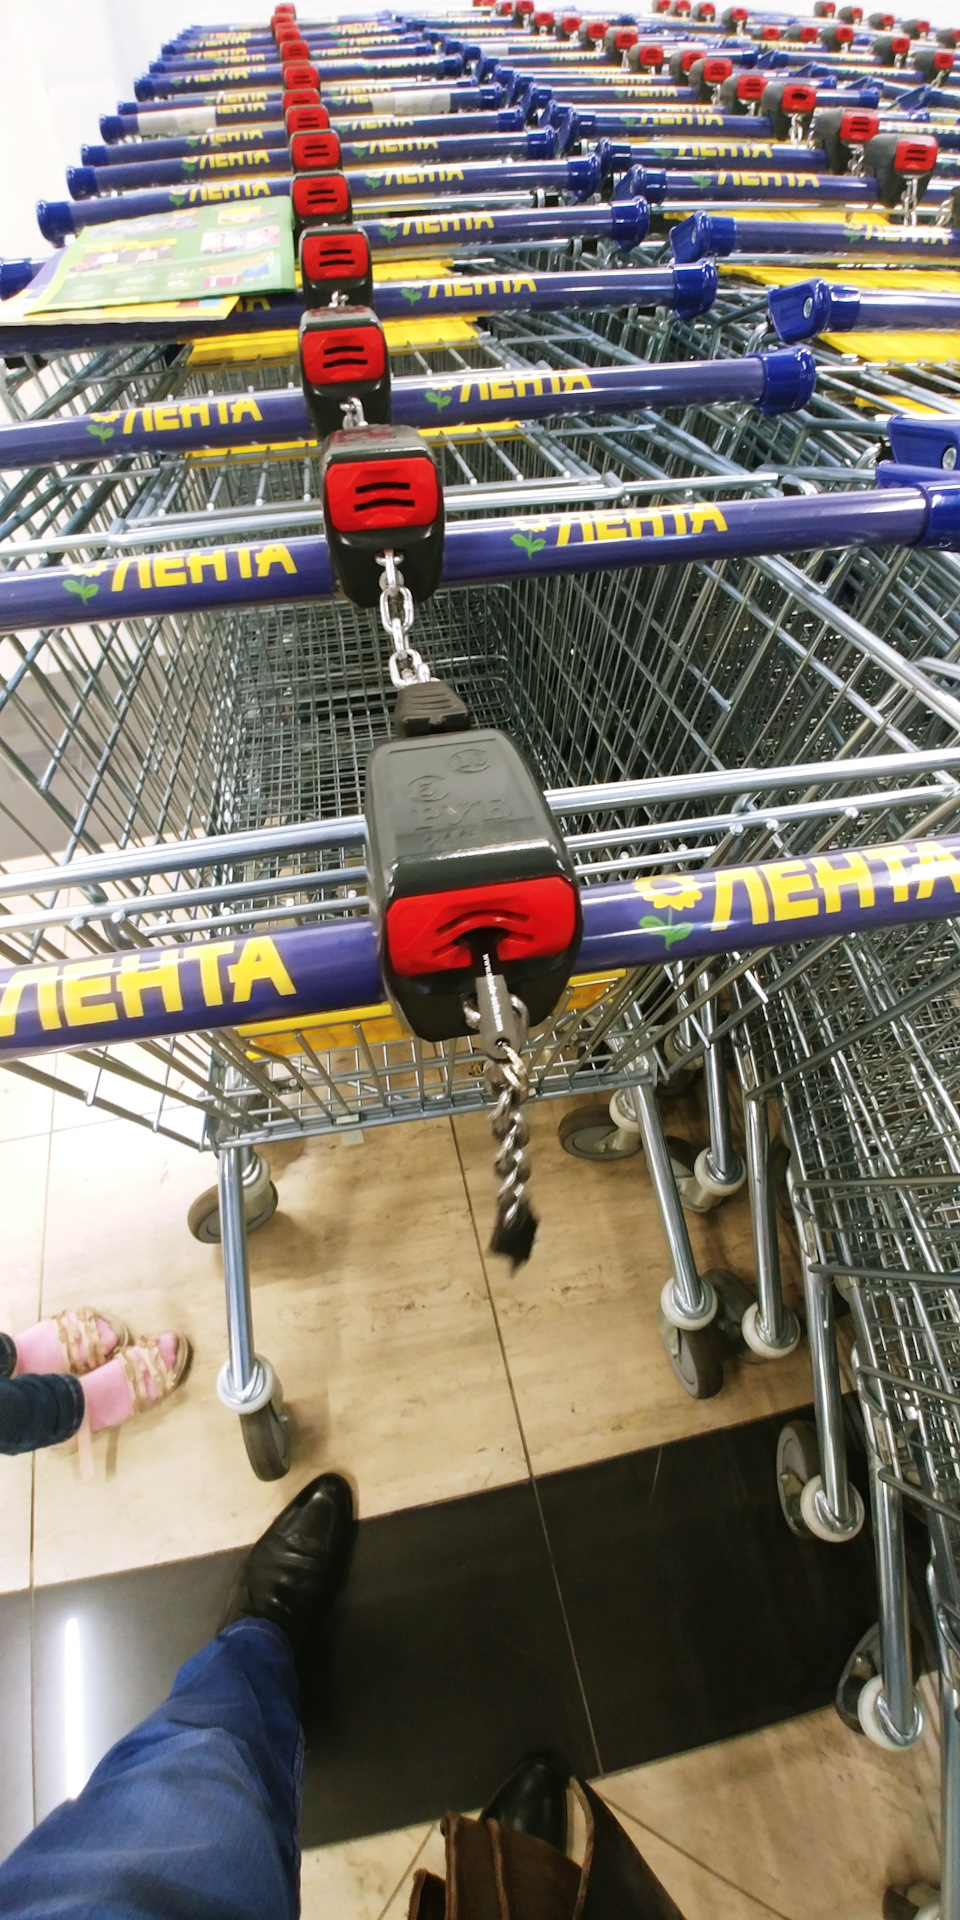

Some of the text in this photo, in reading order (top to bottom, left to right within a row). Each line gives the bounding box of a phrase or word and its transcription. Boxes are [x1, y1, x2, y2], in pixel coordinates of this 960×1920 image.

[199, 149, 270, 169] ЛЕНТА
[384, 166, 464, 186] ЛЕНТА
[189, 181, 271, 202] ЛЕНТА
[717, 171, 820, 188] ЛЕНТА
[402, 213, 495, 236] ЛЕНТА
[428, 275, 537, 299] ЛЕНТА
[459, 369, 592, 403] ЛЕНТА
[122, 397, 263, 434] ЛЕНТА
[556, 502, 728, 547] ЛЕНТА
[111, 543, 298, 592] ЛЕНТА
[711, 840, 960, 932] ЛЕНТА
[0, 935, 297, 1038] ЛЕНТА
[482, 952, 504, 1033] www.skoda-auto.com
